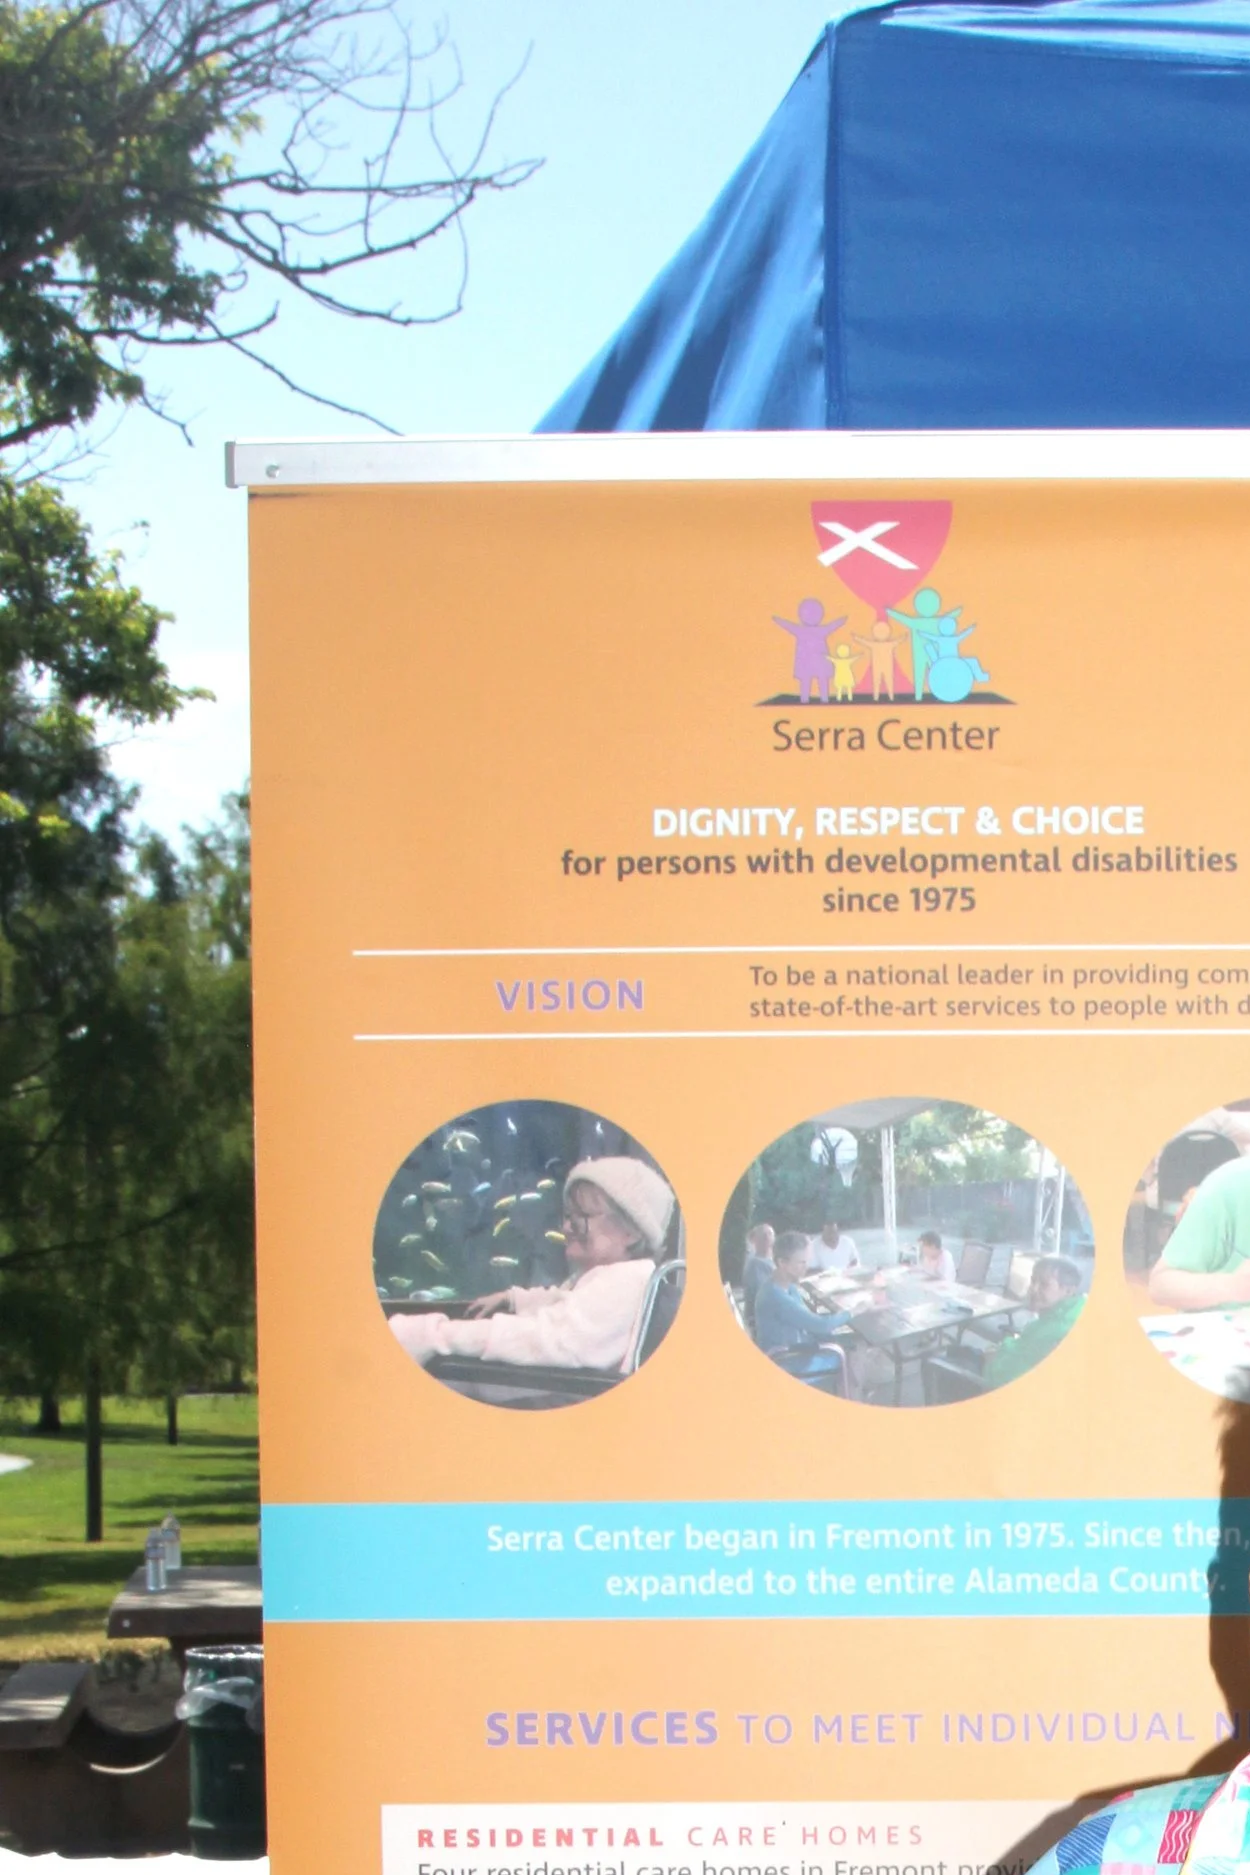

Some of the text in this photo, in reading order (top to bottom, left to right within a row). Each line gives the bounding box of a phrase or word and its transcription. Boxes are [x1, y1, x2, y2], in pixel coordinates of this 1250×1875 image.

[773, 719, 1000, 751] Serra Center
[652, 804, 1145, 840] DIGNITY, RESPECT & CHOICE
[561, 846, 1237, 882] for persons with developmental disabilities
[823, 887, 976, 912] since 1975
[749, 966, 777, 986] To
[787, 965, 815, 986] be
[824, 970, 837, 985] a
[847, 964, 949, 985] national
[958, 963, 1034, 985] leader
[1043, 964, 1063, 984] in
[1074, 963, 1188, 989] providing
[494, 979, 644, 1013] VISION
[750, 995, 937, 1017] state-of-the-art
[946, 996, 1041, 1016] services
[1049, 997, 1075, 1016] to
[1084, 995, 1167, 1020] people
[1176, 995, 1228, 1015] with
[488, 1525, 564, 1551] Serra
[575, 1525, 675, 1551] Center
[686, 1524, 778, 1555] began
[790, 1523, 815, 1548] in
[827, 1524, 954, 1548] Fremont
[966, 1523, 991, 1548] in
[1002, 1523, 1073, 1547] 1975.
[1085, 1522, 1161, 1547] Since
[1173, 1521, 1250, 1550] then,
[606, 1566, 1226, 1601] expanded to the entire Alameda County.
[485, 1709, 718, 1748] SERVICES
[736, 1713, 792, 1745] TO
[813, 1712, 923, 1744] MEET
[942, 1712, 1195, 1744] INDIVIDUAL
[418, 1825, 922, 1848] RESIDENTIAL CARE HOMES
